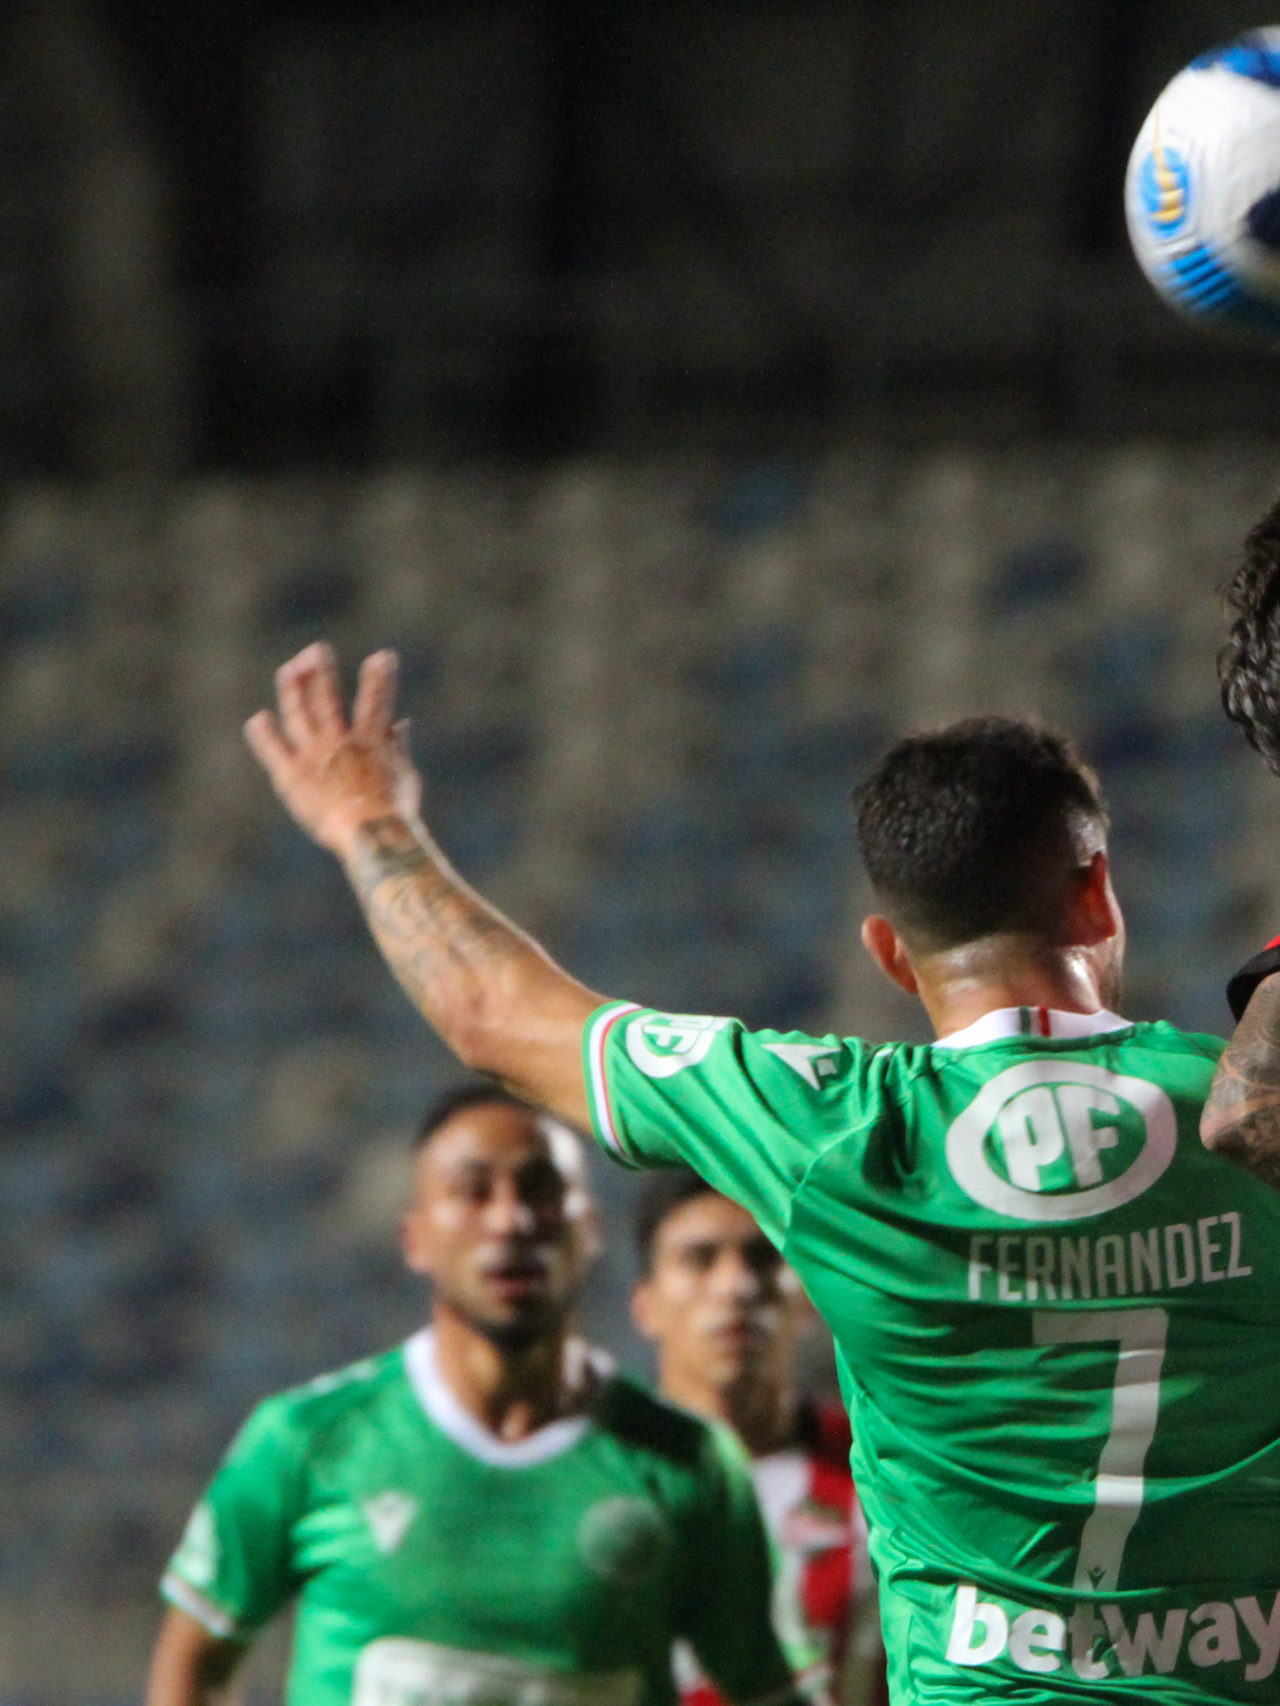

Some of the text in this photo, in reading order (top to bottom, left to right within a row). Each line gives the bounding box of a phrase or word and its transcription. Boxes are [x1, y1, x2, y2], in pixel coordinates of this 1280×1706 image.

[1000, 1084, 1121, 1192] PF
[968, 1211, 1253, 1301] FERNANDEZ
[1032, 1308, 1169, 1612] 7
